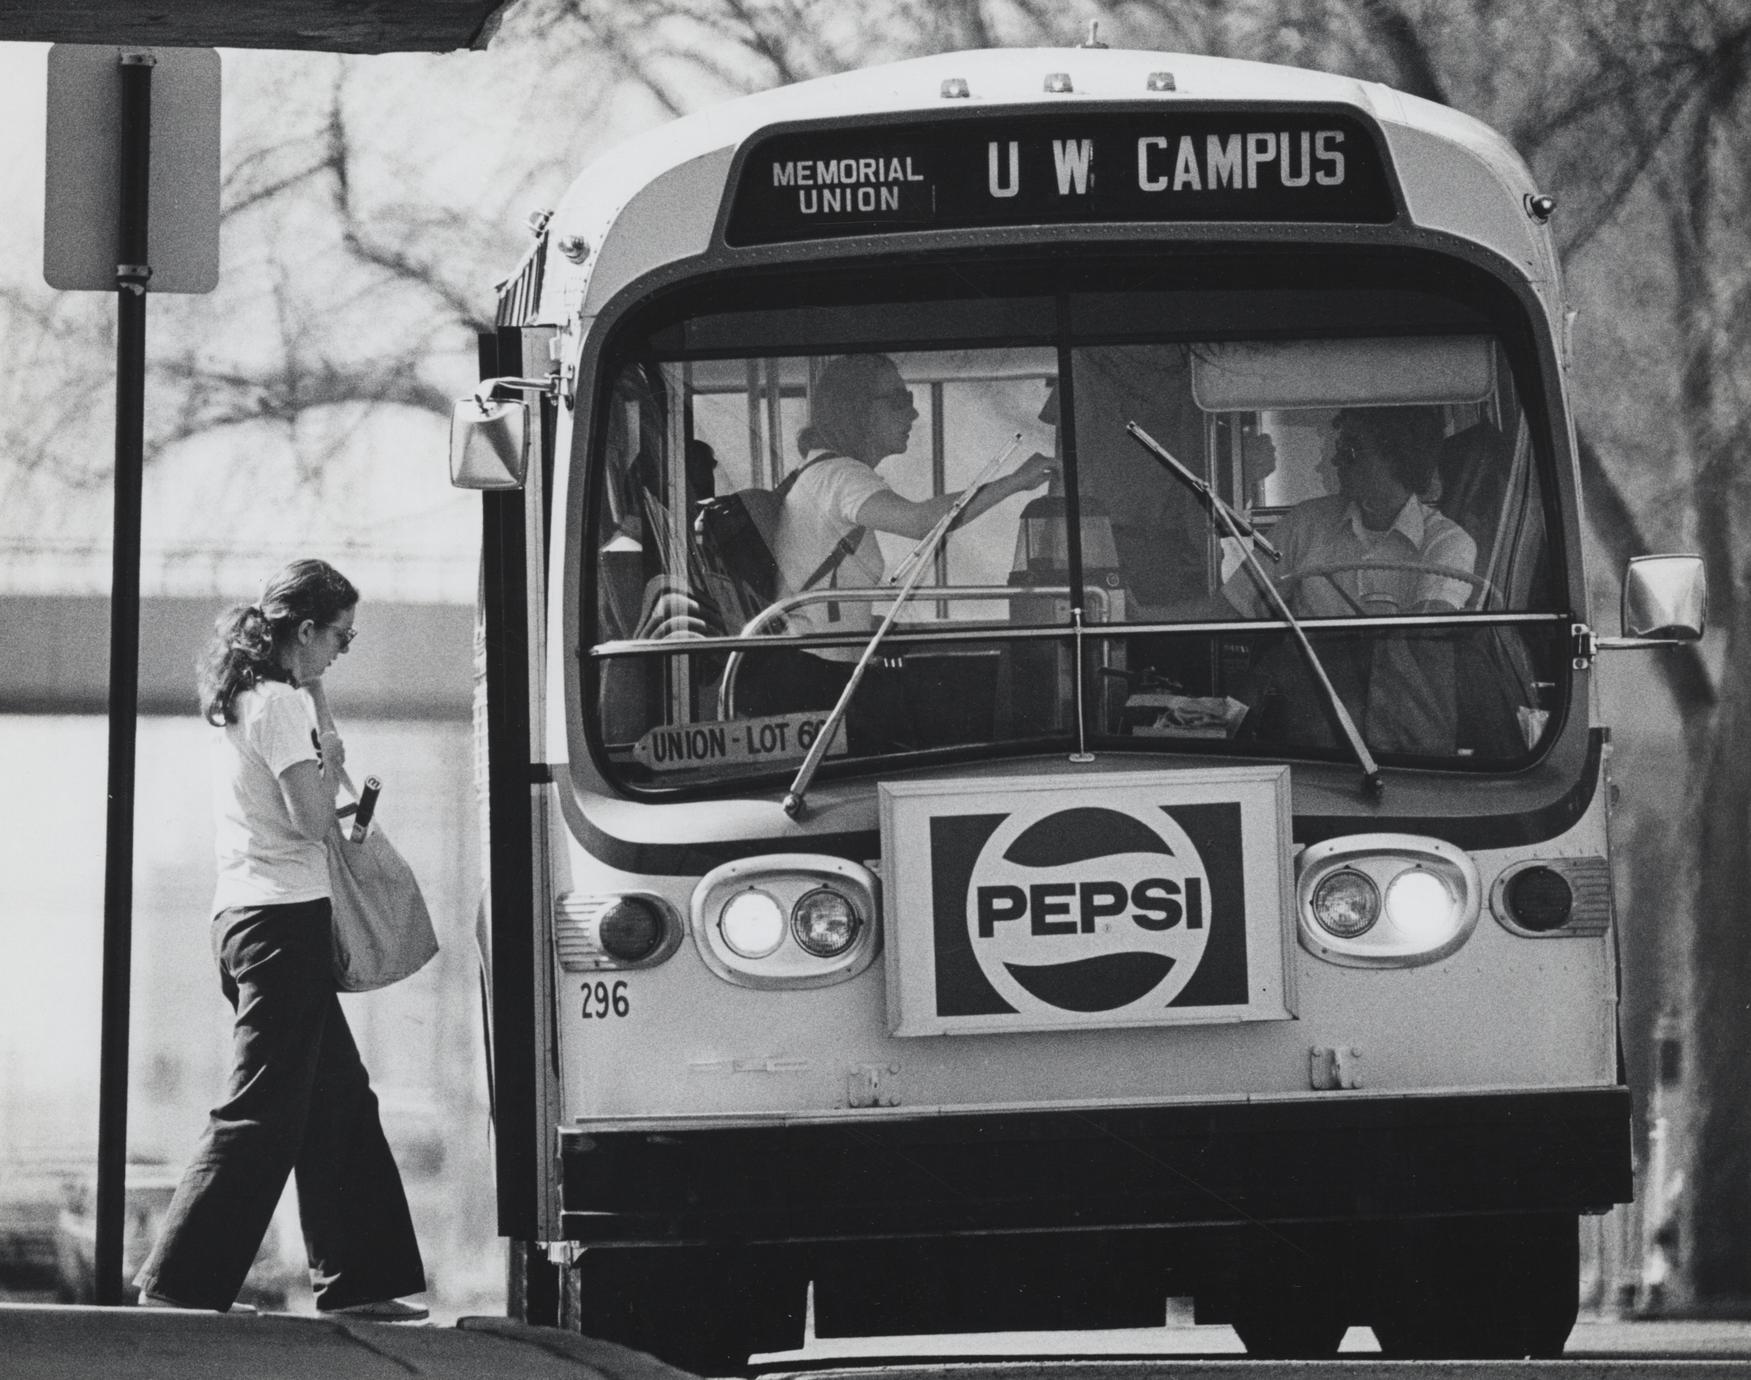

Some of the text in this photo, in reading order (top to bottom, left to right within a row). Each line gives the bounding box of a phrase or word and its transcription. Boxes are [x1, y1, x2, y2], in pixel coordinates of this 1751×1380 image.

[772, 156, 924, 187] MEMORIAL
[988, 130, 1345, 197] U W CAMPUS
[800, 185, 899, 214] UNION
[652, 727, 726, 762] UNION
[747, 722, 789, 754] LOT
[977, 877, 1203, 938] PEPSI
[580, 980, 630, 1019] 296
